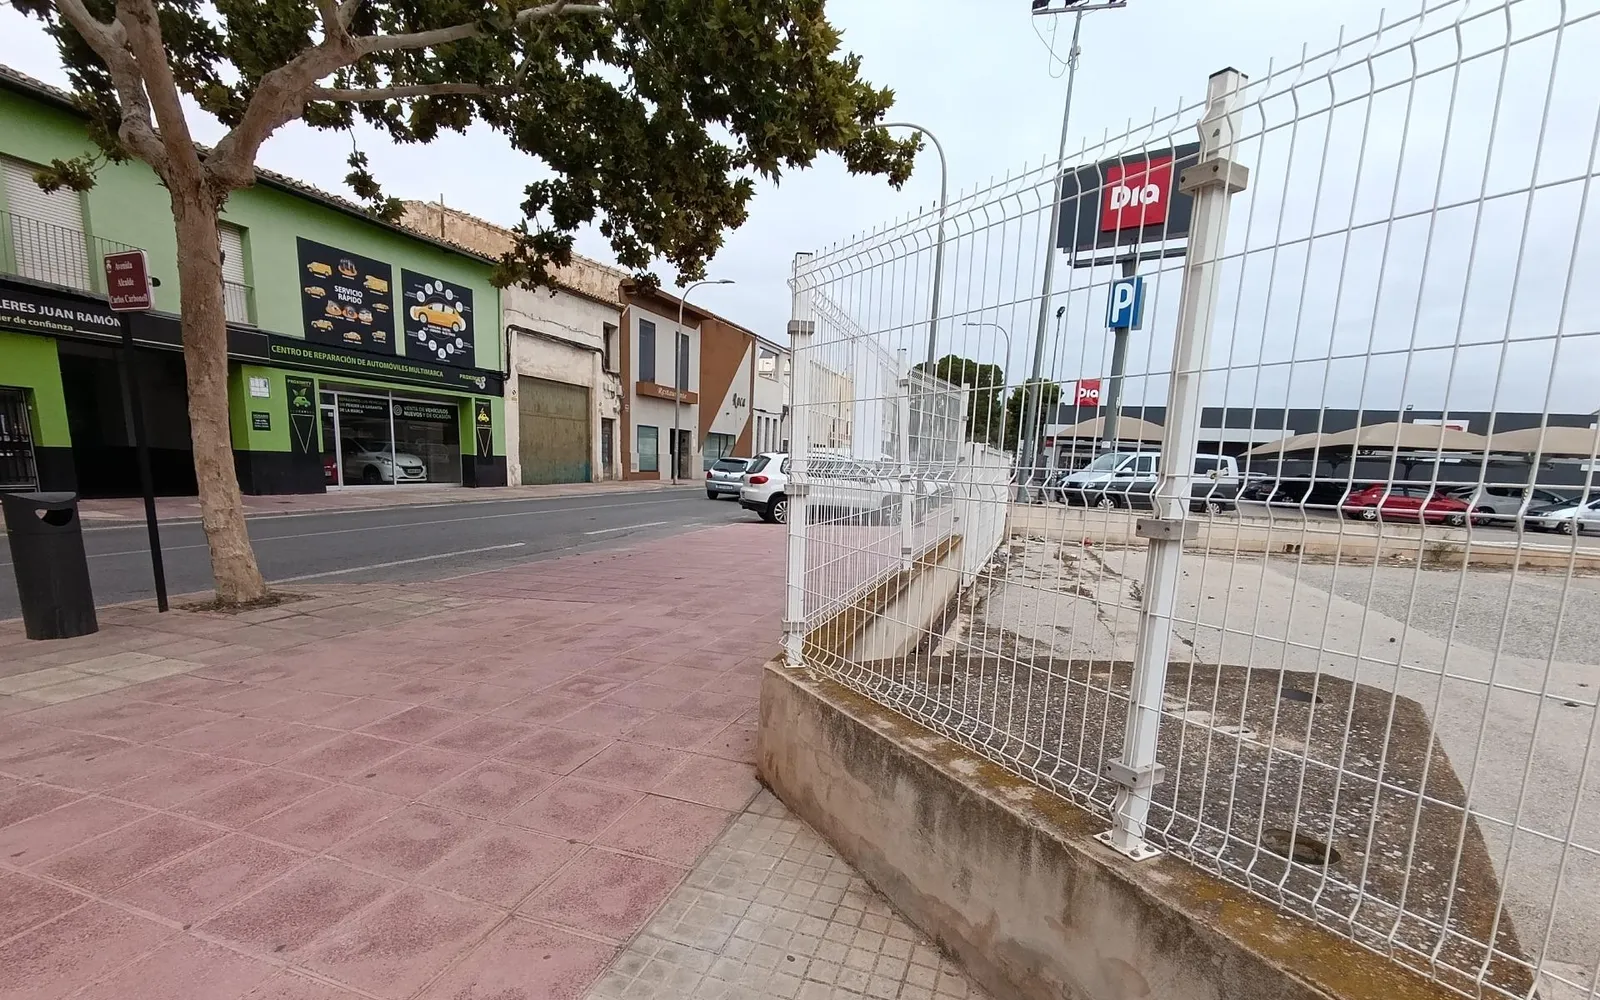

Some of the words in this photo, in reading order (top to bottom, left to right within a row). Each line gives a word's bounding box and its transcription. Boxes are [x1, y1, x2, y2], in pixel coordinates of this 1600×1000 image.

[115, 261, 133, 270] Avenida
[117, 277, 134, 287] Alcalde
[334, 285, 363, 298] SERVICIO
[1112, 282, 1133, 323] P
[13, 316, 26, 324] de
[28, 320, 73, 331] confianza
[39, 306, 74, 319] JUAN
[77, 312, 121, 327] RAMÓN
[271, 344, 302, 357] CENTRO
[302, 349, 313, 358] DE
[313, 351, 357, 365] REPARACIÓN
[357, 358, 366, 367] DE
[366, 360, 408, 373] AUTOMÓVILES
[409, 366, 443, 377] MULTIMARCA
[732, 393, 746, 408] Roca
